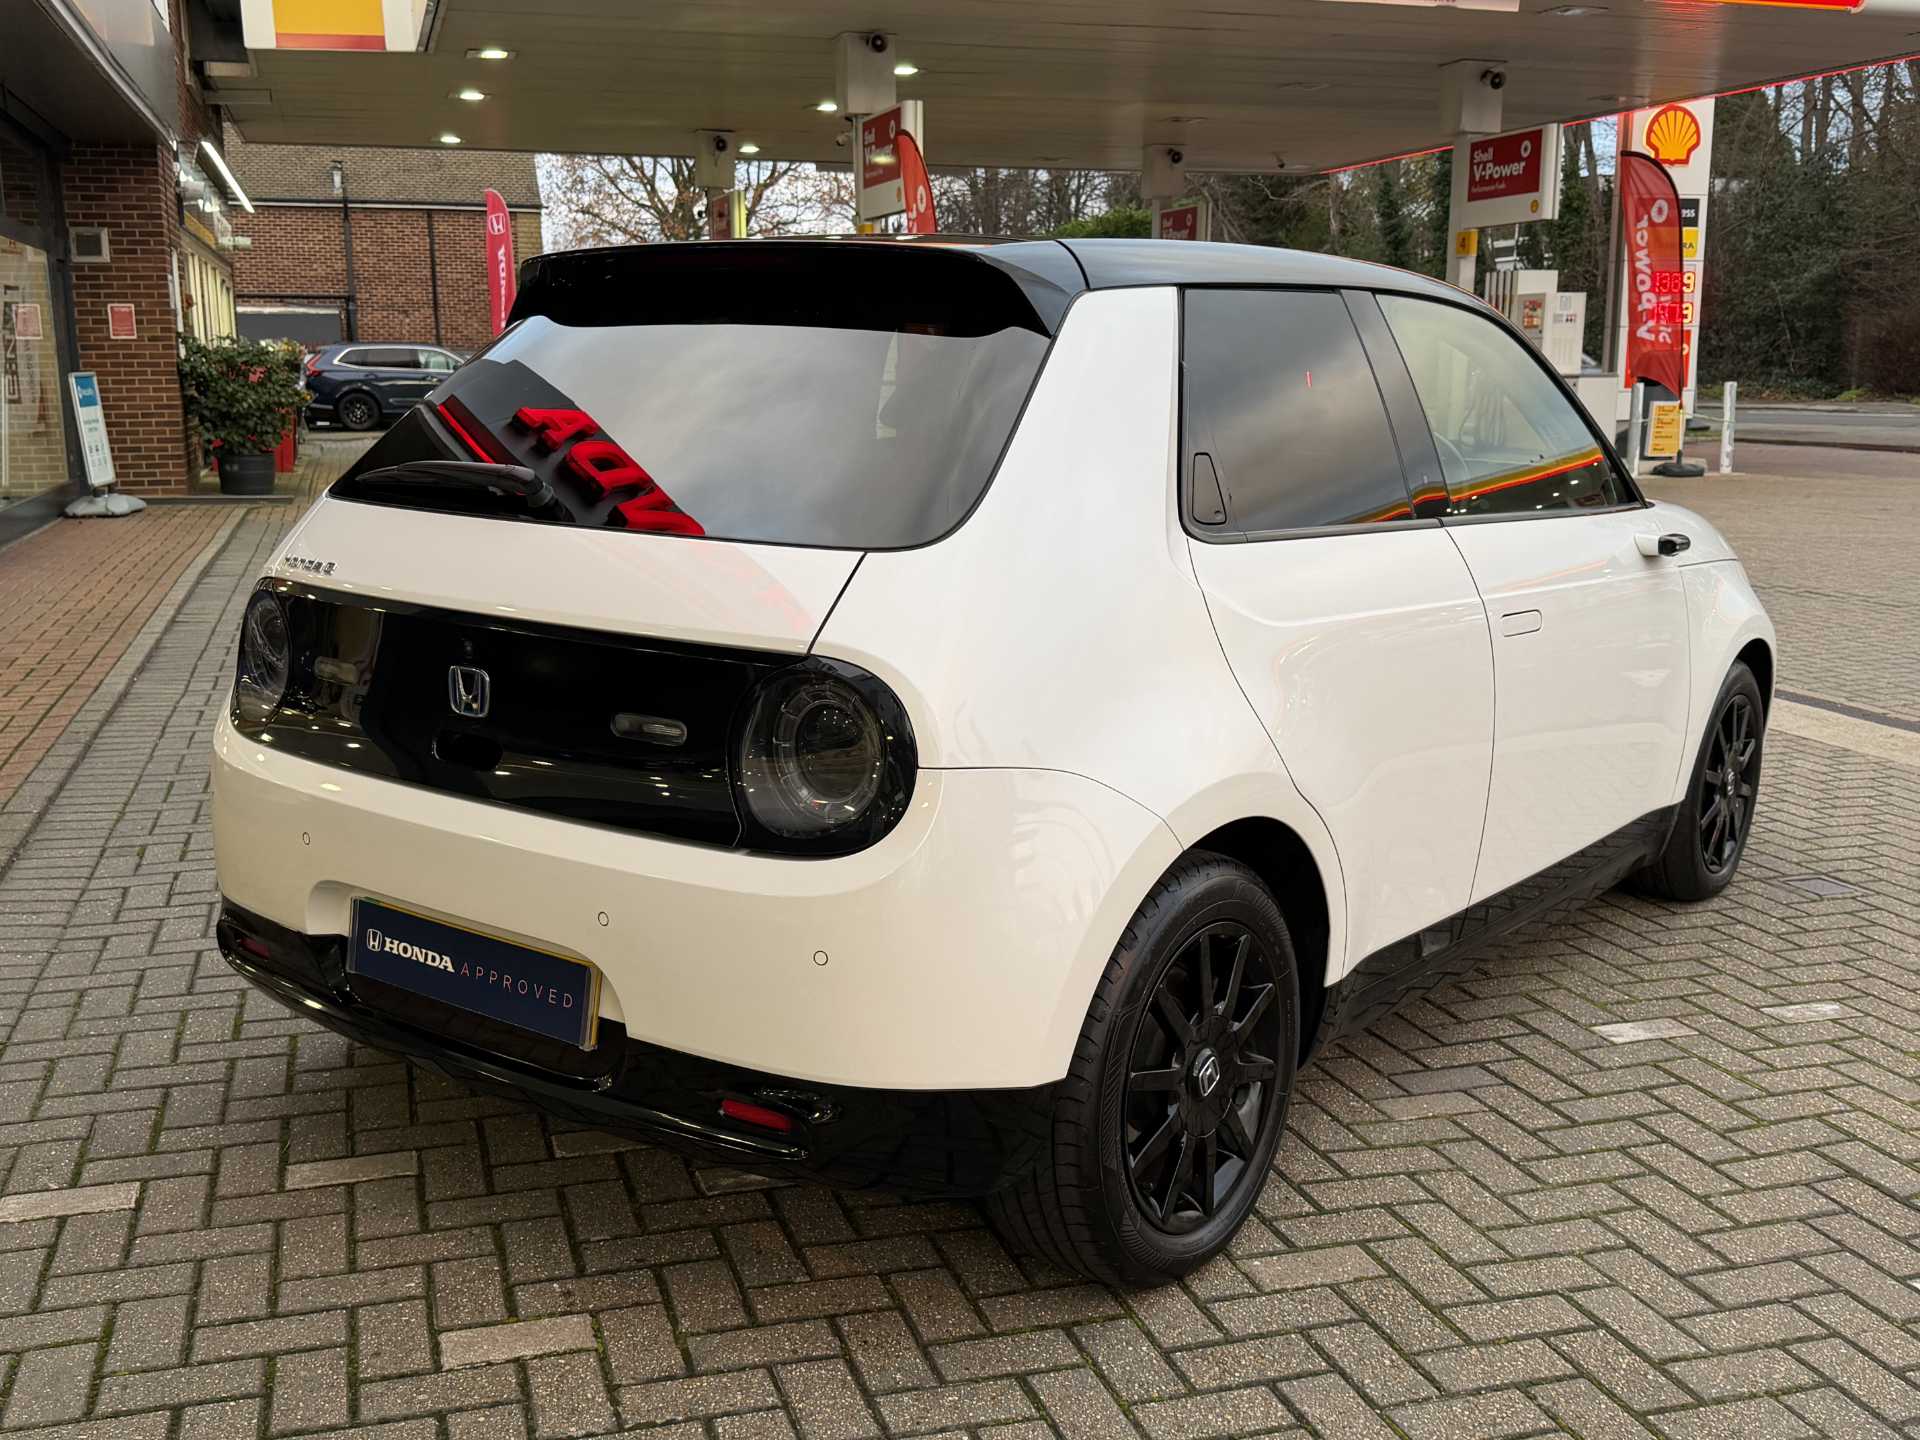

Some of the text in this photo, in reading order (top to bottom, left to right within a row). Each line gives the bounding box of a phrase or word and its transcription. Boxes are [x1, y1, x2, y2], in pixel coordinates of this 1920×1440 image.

[1473, 147, 1494, 163] Shell
[1473, 161, 1526, 182] V-Power
[384, 937, 573, 1008] HONDA APPROVED
